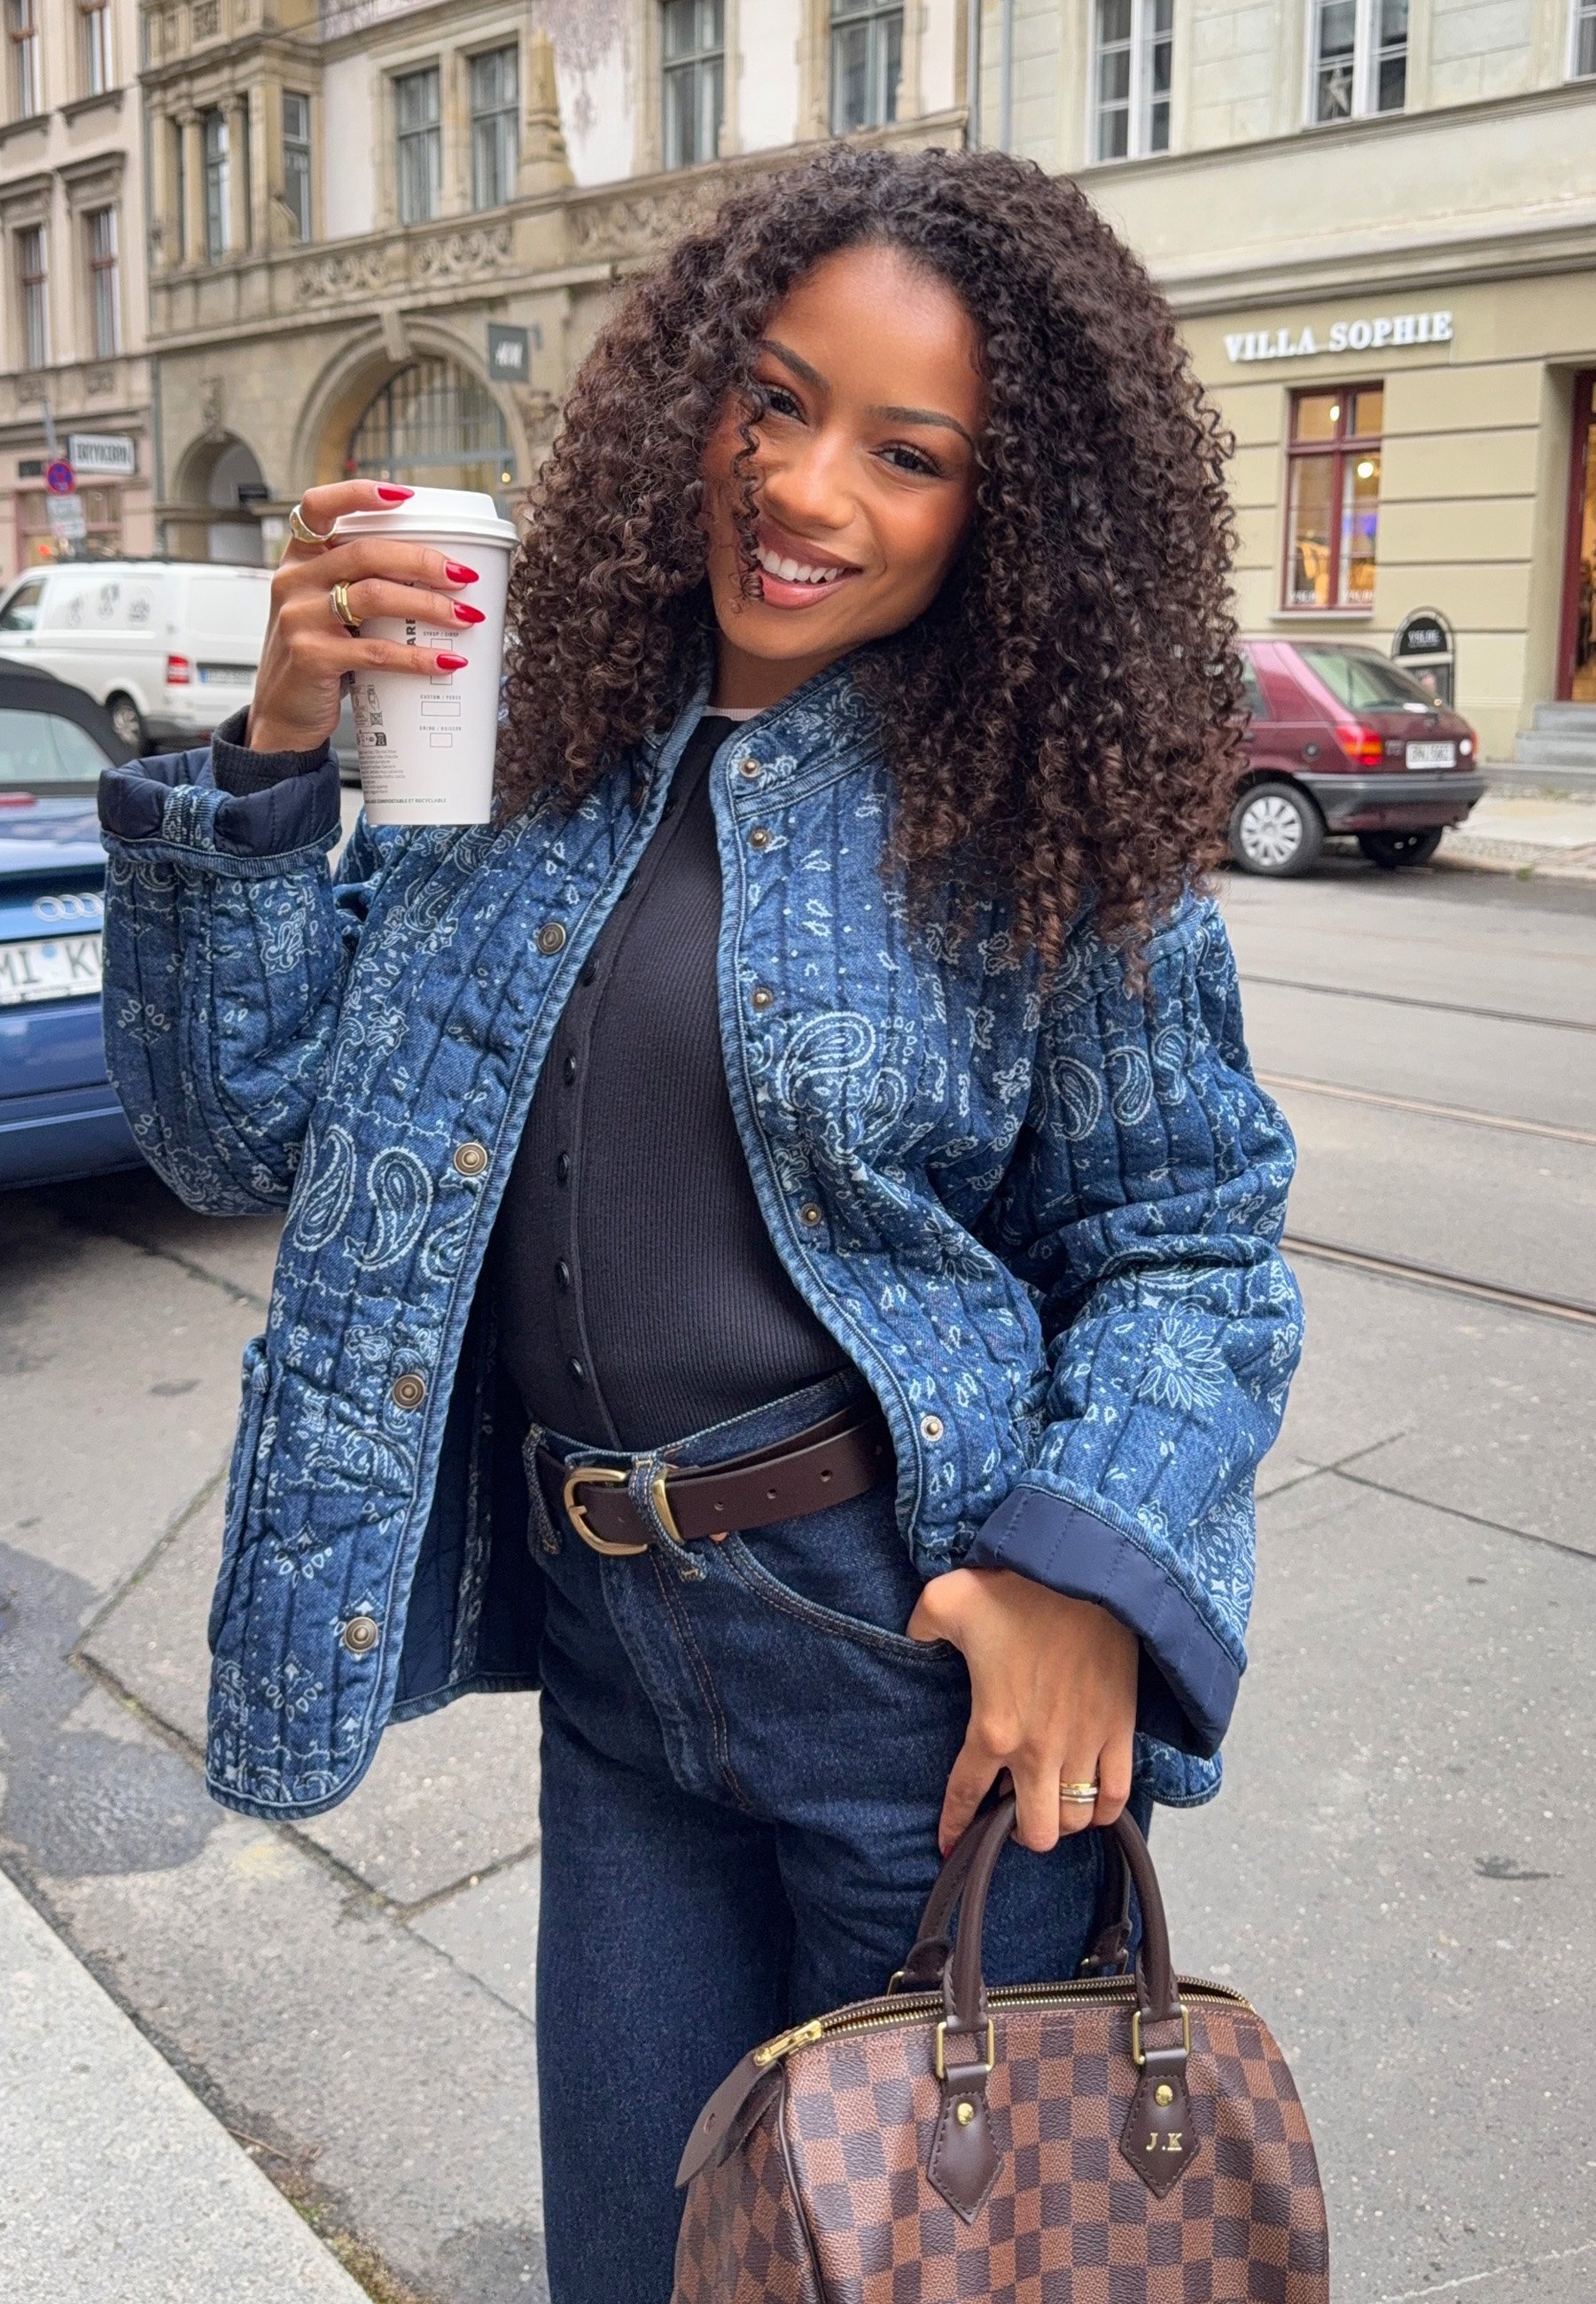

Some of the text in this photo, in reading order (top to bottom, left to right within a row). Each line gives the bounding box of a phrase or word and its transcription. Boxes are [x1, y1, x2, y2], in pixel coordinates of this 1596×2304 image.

[1224, 310, 1453, 362] VILLA SOPHIE
[1145, 2132, 1183, 2152] J.K
